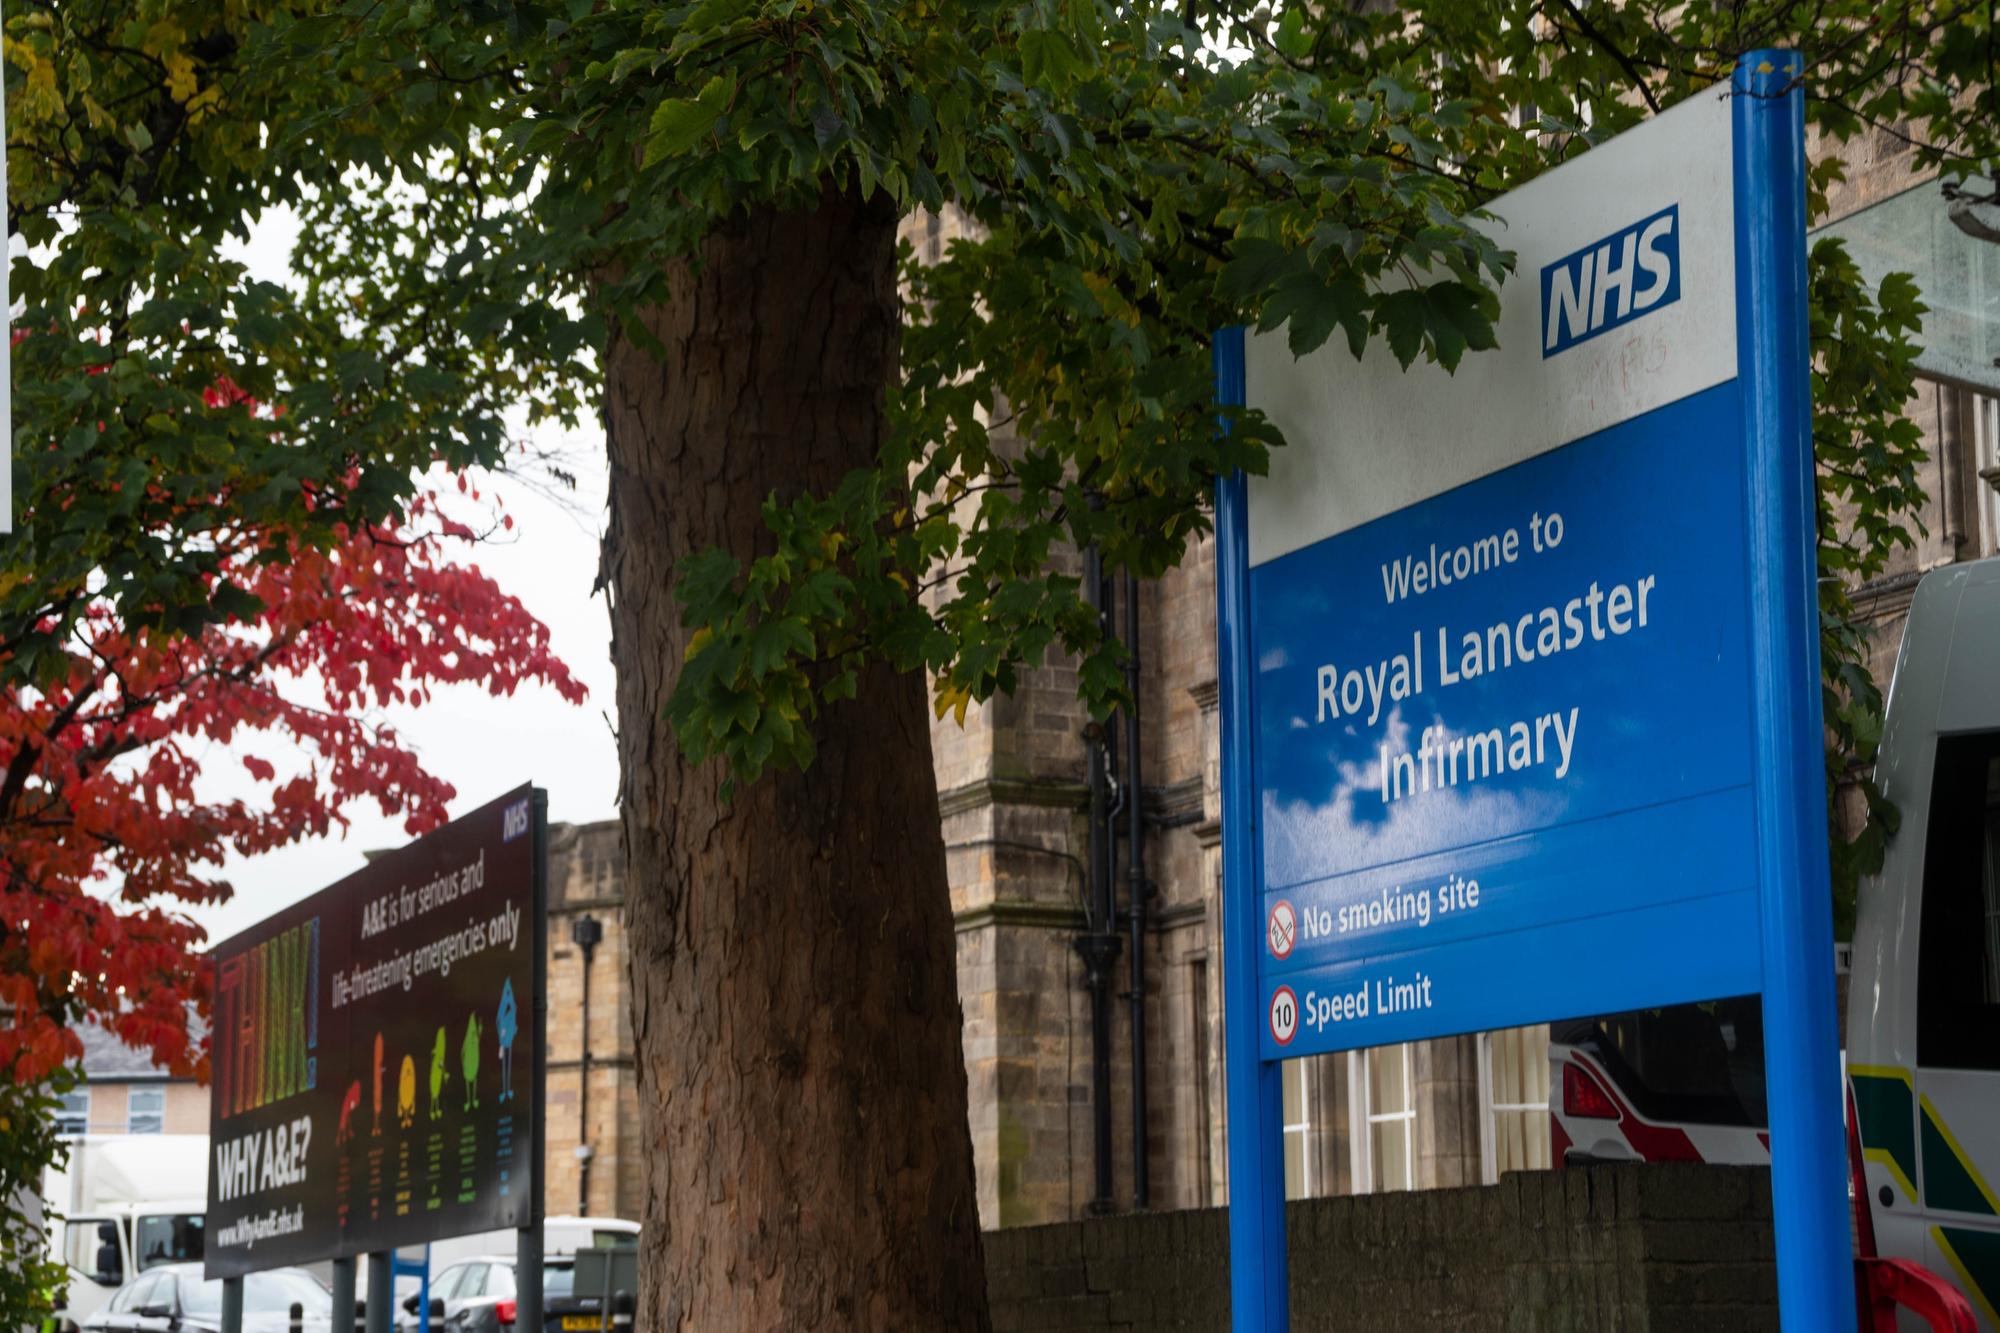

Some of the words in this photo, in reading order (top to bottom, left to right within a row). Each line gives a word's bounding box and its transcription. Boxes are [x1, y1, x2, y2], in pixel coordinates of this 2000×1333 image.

[1546, 214, 1674, 350] NHS
[1381, 527, 1519, 604] Welcome
[1529, 511, 1564, 553] to
[1316, 630, 1423, 727] Royal
[1438, 574, 1656, 687] Lancaster
[1380, 706, 1579, 804] Infirmary
[503, 799, 528, 842] NHS
[361, 896, 388, 940] A&E
[388, 893, 398, 928] is
[400, 885, 416, 922] for
[417, 871, 459, 914] serious
[461, 848, 484, 895] and
[1303, 906, 1332, 940] No
[1338, 885, 1431, 933] smoking
[1438, 873, 1480, 914] site
[332, 949, 413, 1009] life-threatening
[413, 917, 486, 977] emergencies
[488, 900, 521, 951] only
[1275, 1003, 1292, 1029] 10
[1305, 980, 1369, 1033] Speed
[1376, 971, 1433, 1015] Limit
[216, 1131, 262, 1202] WHY
[260, 1114, 313, 1192] A&E?
